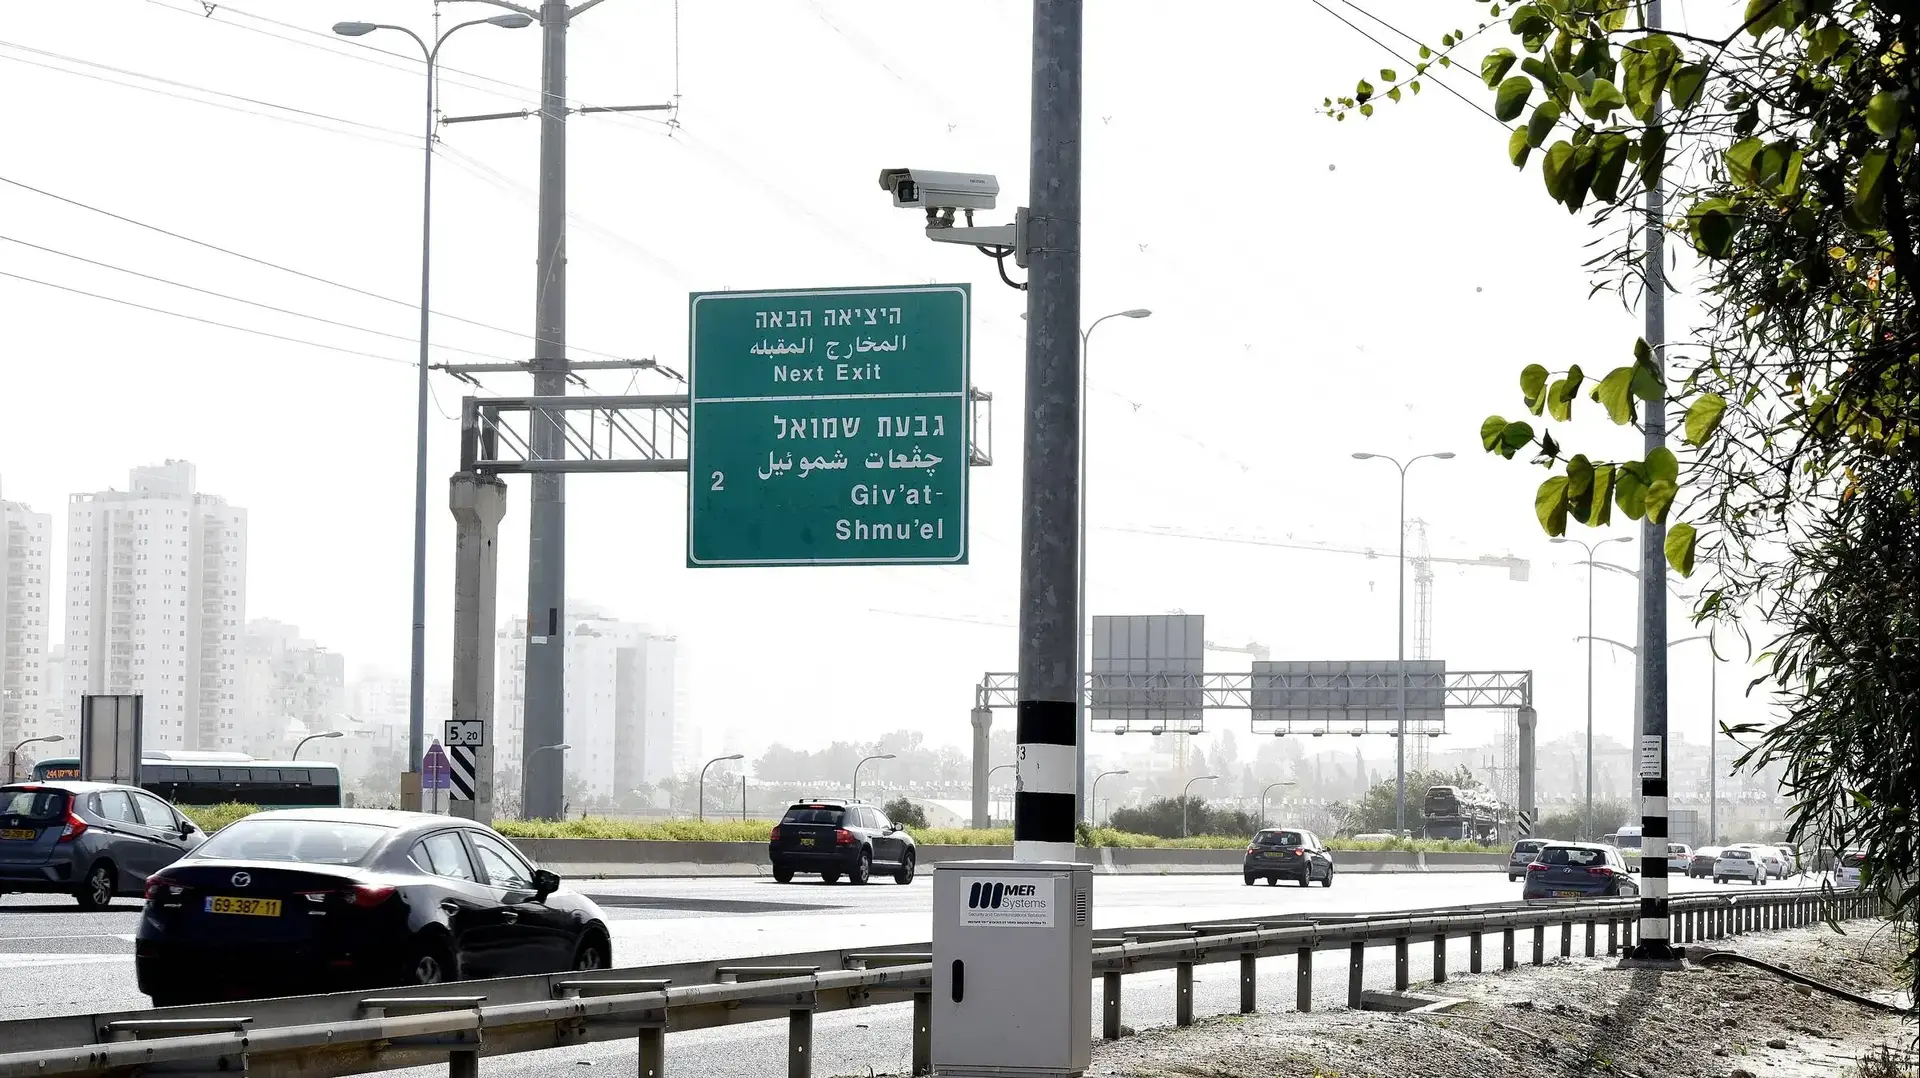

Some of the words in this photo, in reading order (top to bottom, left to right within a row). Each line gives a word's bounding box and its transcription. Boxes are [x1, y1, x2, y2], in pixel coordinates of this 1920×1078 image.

[755, 310, 812, 329] הבאה
[824, 307, 901, 326] היציאה
[750, 336, 814, 359] المقبله
[825, 334, 907, 361] المخارج
[774, 365, 824, 382] Next
[836, 363, 881, 381] Exit
[773, 415, 861, 439] שמואל
[877, 415, 945, 437] גבעת
[758, 449, 848, 480] شموئيل
[711, 471, 724, 491] 2
[851, 484, 943, 505] Giv'at-
[835, 518, 943, 540] Shmu'el
[1003, 884, 1036, 896] MER
[1001, 897, 1047, 909] Systems
